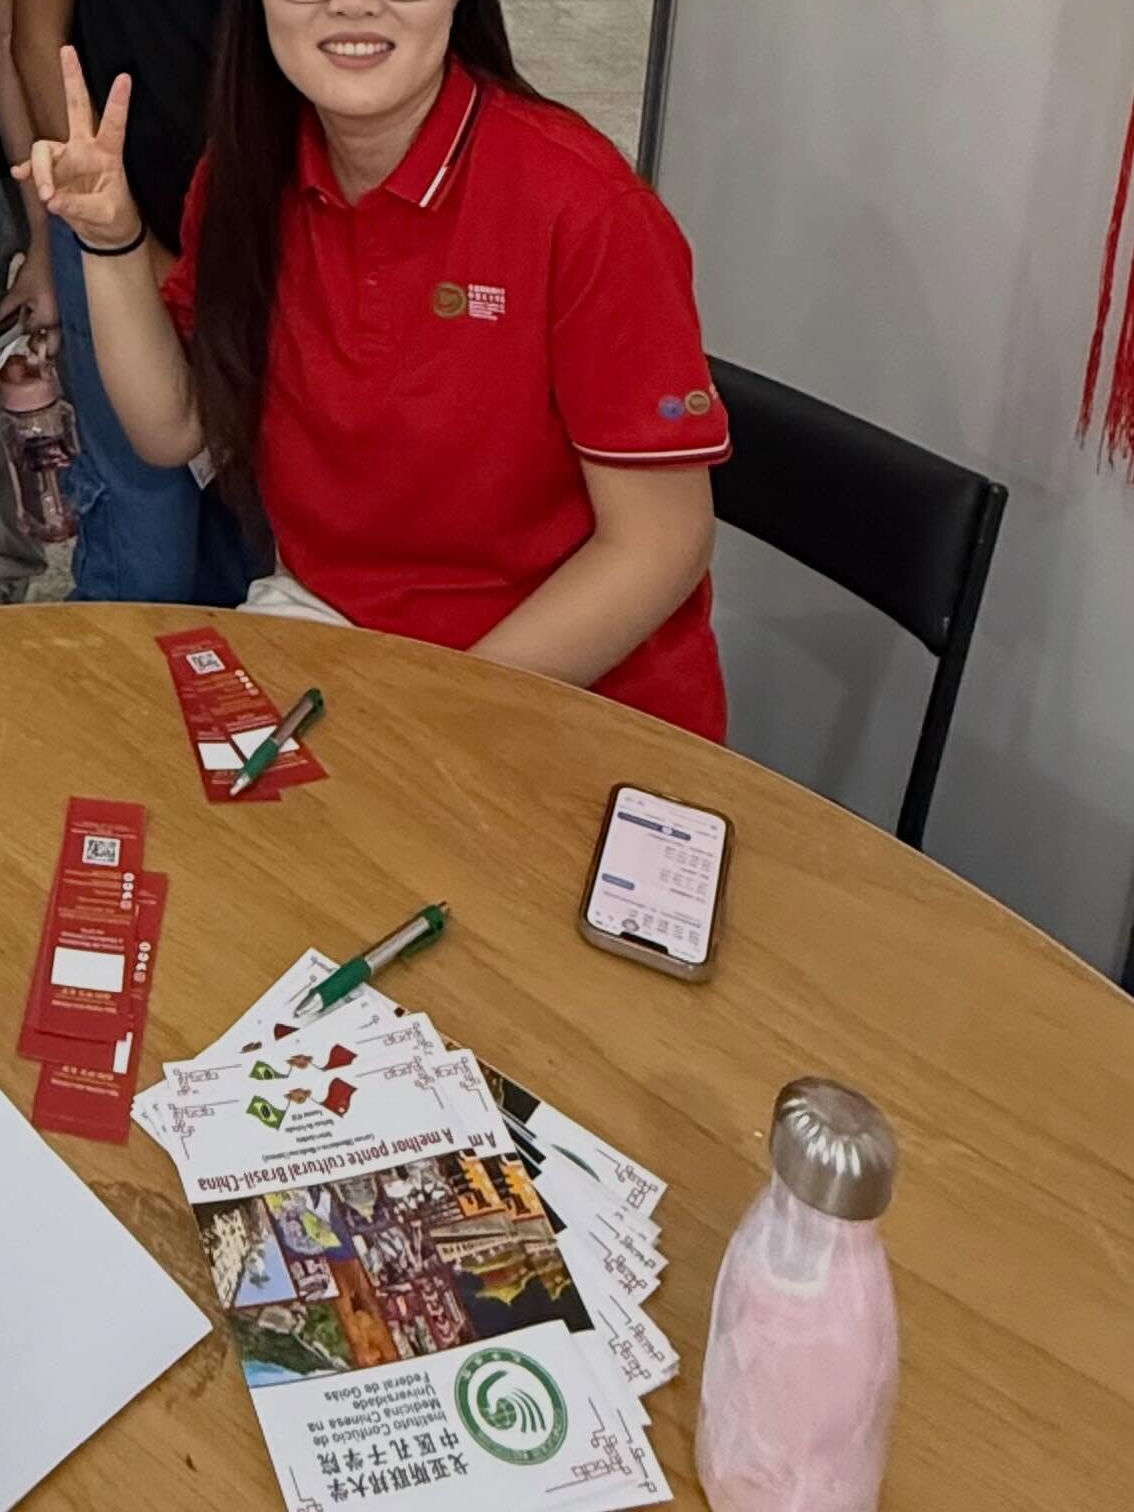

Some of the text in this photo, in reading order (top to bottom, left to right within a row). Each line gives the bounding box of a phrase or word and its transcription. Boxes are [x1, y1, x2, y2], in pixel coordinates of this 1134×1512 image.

[347, 1139, 390, 1161] ponte
[392, 1130, 441, 1155] melhor
[441, 1127, 455, 1145] A
[198, 1162, 288, 1193] Brasil-China
[289, 1153, 345, 1178] cultural
[324, 1371, 431, 1401] Federal de Goiás
[353, 1383, 437, 1410] Universidade
[307, 1397, 442, 1433] Medicina Chinesa na
[313, 1411, 448, 1447] Instituto Confúcio de
[317, 1427, 459, 1475] 中医孔子学院
[328, 1452, 469, 1503] 戈亚斯联邦大学
